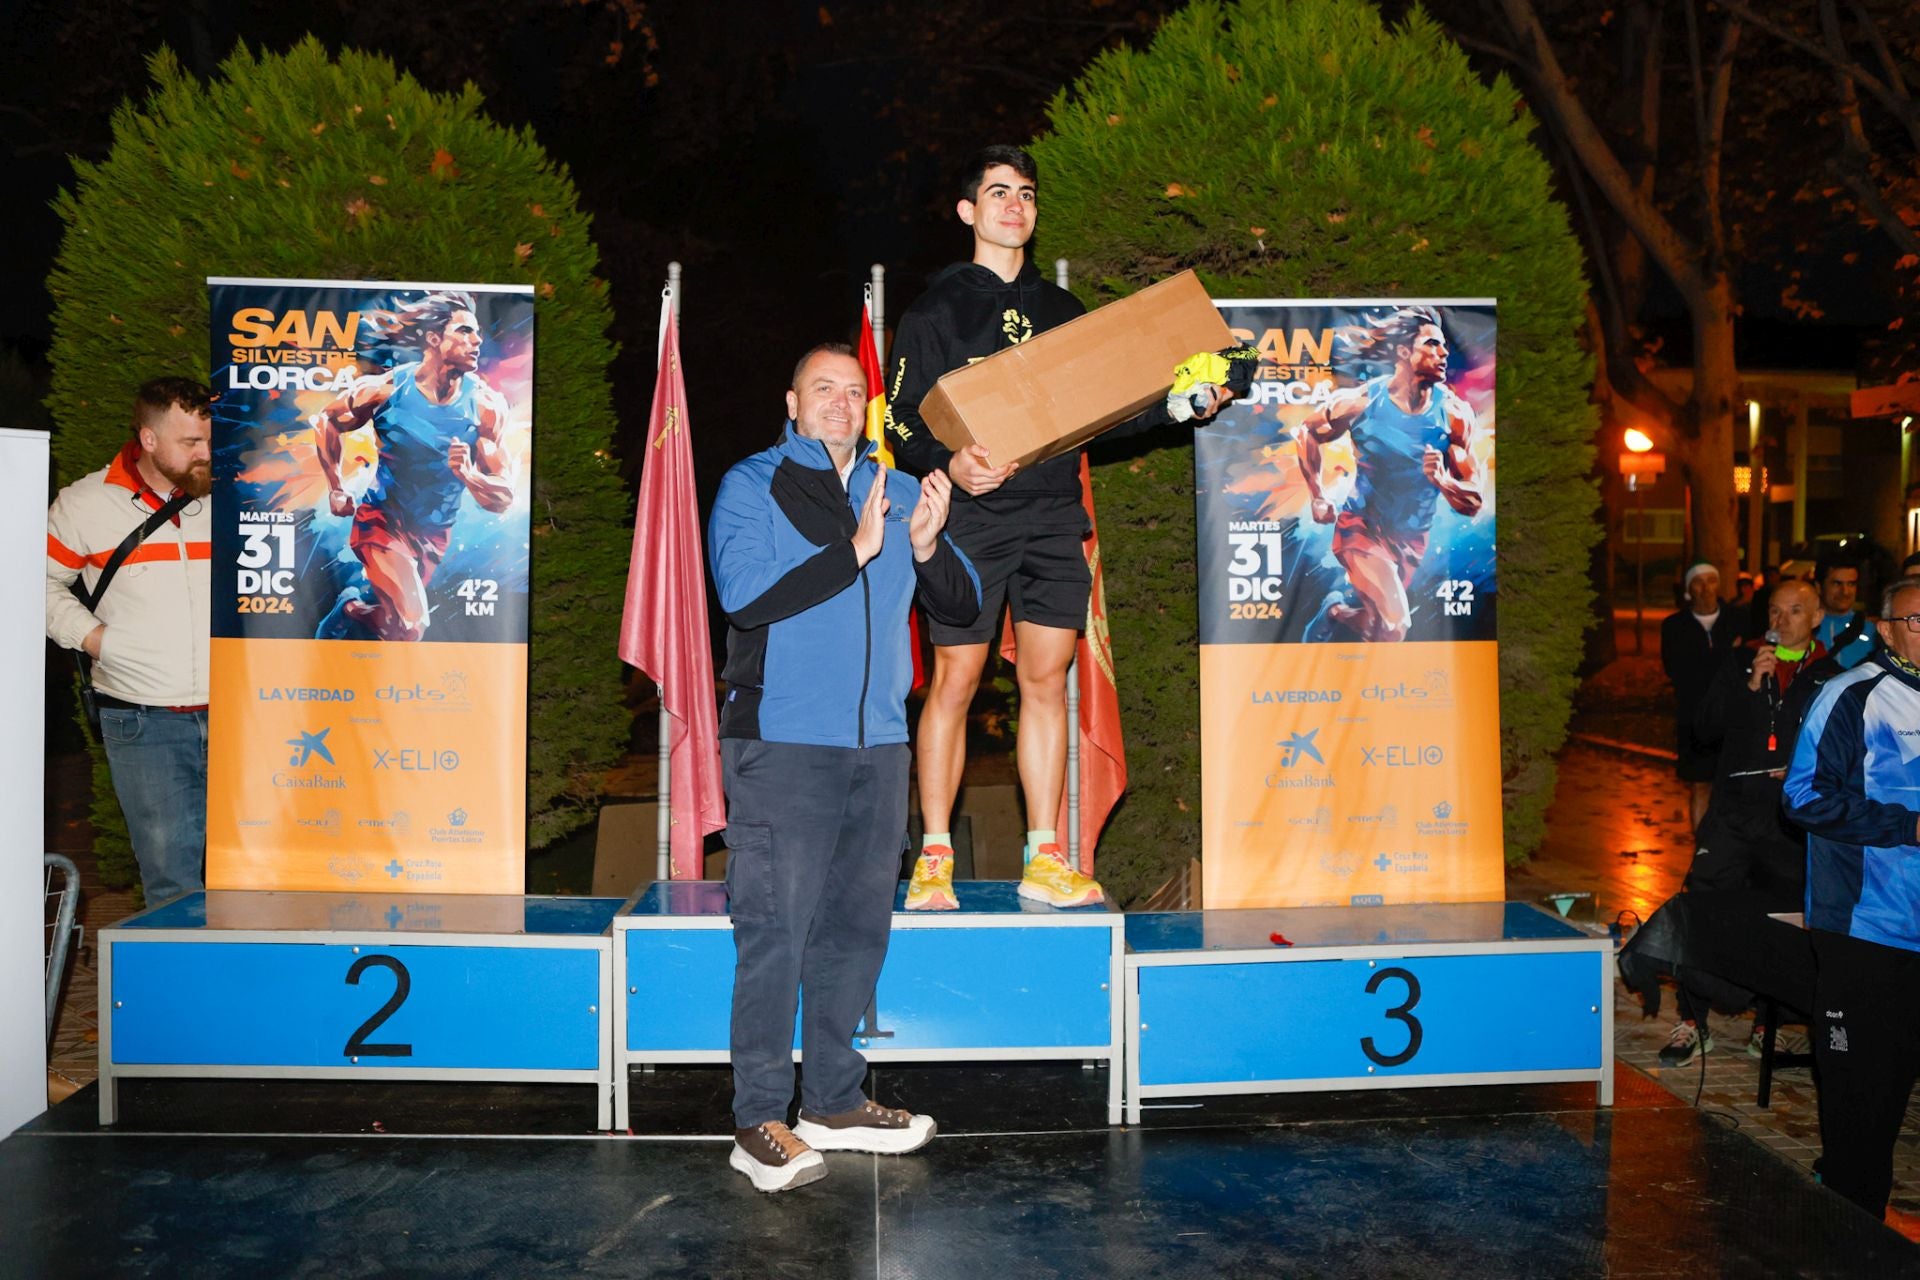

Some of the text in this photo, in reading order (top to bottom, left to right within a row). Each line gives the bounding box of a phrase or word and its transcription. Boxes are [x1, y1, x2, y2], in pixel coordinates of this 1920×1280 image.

[228, 308, 360, 349] SAN
[1229, 328, 1334, 364] AN
[232, 349, 357, 365] SILVESTRE
[229, 365, 357, 391] LORCA
[239, 511, 295, 523] MARTES
[1229, 521, 1281, 531] MARTES
[236, 524, 295, 569] 31
[1228, 532, 1282, 576] 31
[237, 569, 295, 595] DIC
[1229, 577, 1282, 601] DIC
[237, 597, 295, 614] 2024
[465, 601, 495, 617] KM
[1229, 603, 1283, 619] 2024
[1444, 601, 1471, 616] KM
[259, 688, 355, 702] LA VERDAD
[375, 683, 446, 704] dpts
[1252, 690, 1342, 703] LA VERDAD
[1361, 683, 1429, 701] dpts
[272, 773, 347, 789] CaixaBank
[1265, 774, 1336, 789] CaixaBank
[343, 954, 412, 1056] 2
[1360, 967, 1423, 1067] 3
